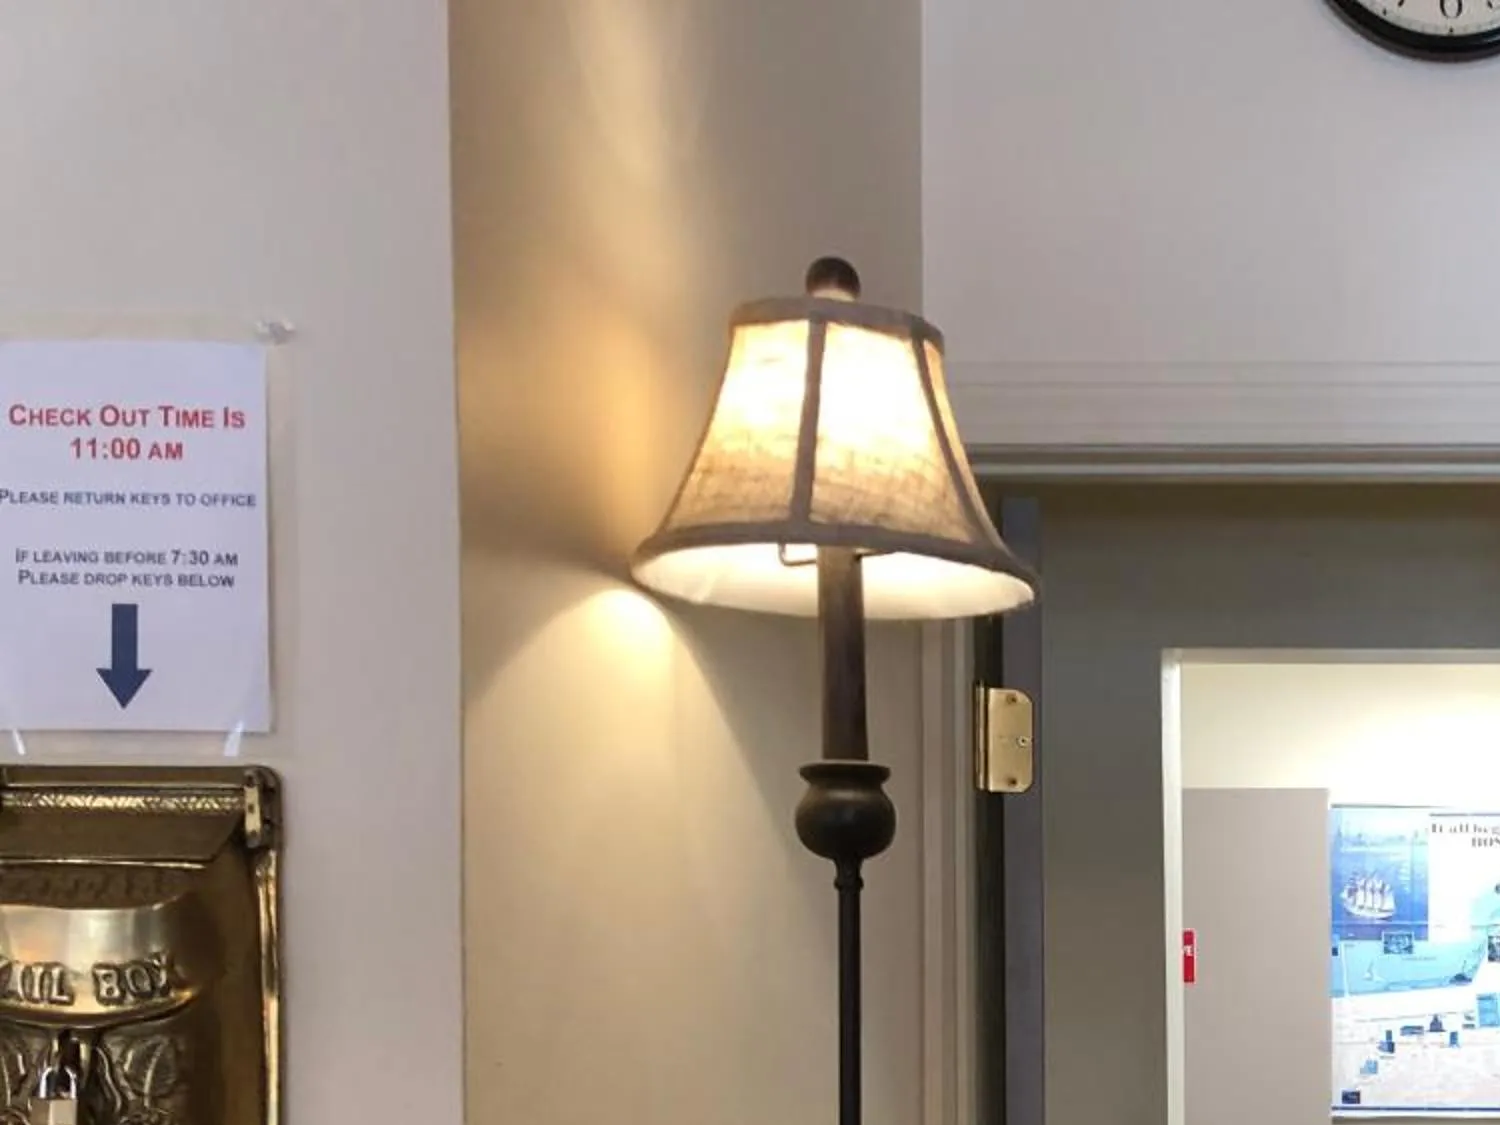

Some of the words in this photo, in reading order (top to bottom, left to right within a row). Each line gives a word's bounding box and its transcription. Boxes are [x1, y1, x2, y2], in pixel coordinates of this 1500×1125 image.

[8, 403, 92, 427] CHECK
[99, 404, 151, 428] OUT
[158, 405, 215, 428] TIME
[223, 406, 246, 429] IS
[70, 436, 141, 460] 11:00
[147, 441, 184, 460] AM
[0, 488, 59, 505] PLEASE
[63, 491, 126, 506] RETURN
[130, 492, 171, 507] KEYS
[176, 493, 197, 507] TO
[200, 493, 256, 508] OFFICE
[15, 548, 29, 563] IF
[33, 550, 99, 564] LEAVING
[104, 551, 166, 566] BEFORE
[171, 549, 210, 566] 7:30
[213, 552, 239, 567] AM
[18, 569, 79, 585] PLEASE
[83, 573, 128, 587] DROP
[132, 574, 173, 587] KEYS
[177, 574, 235, 588] BELOW
